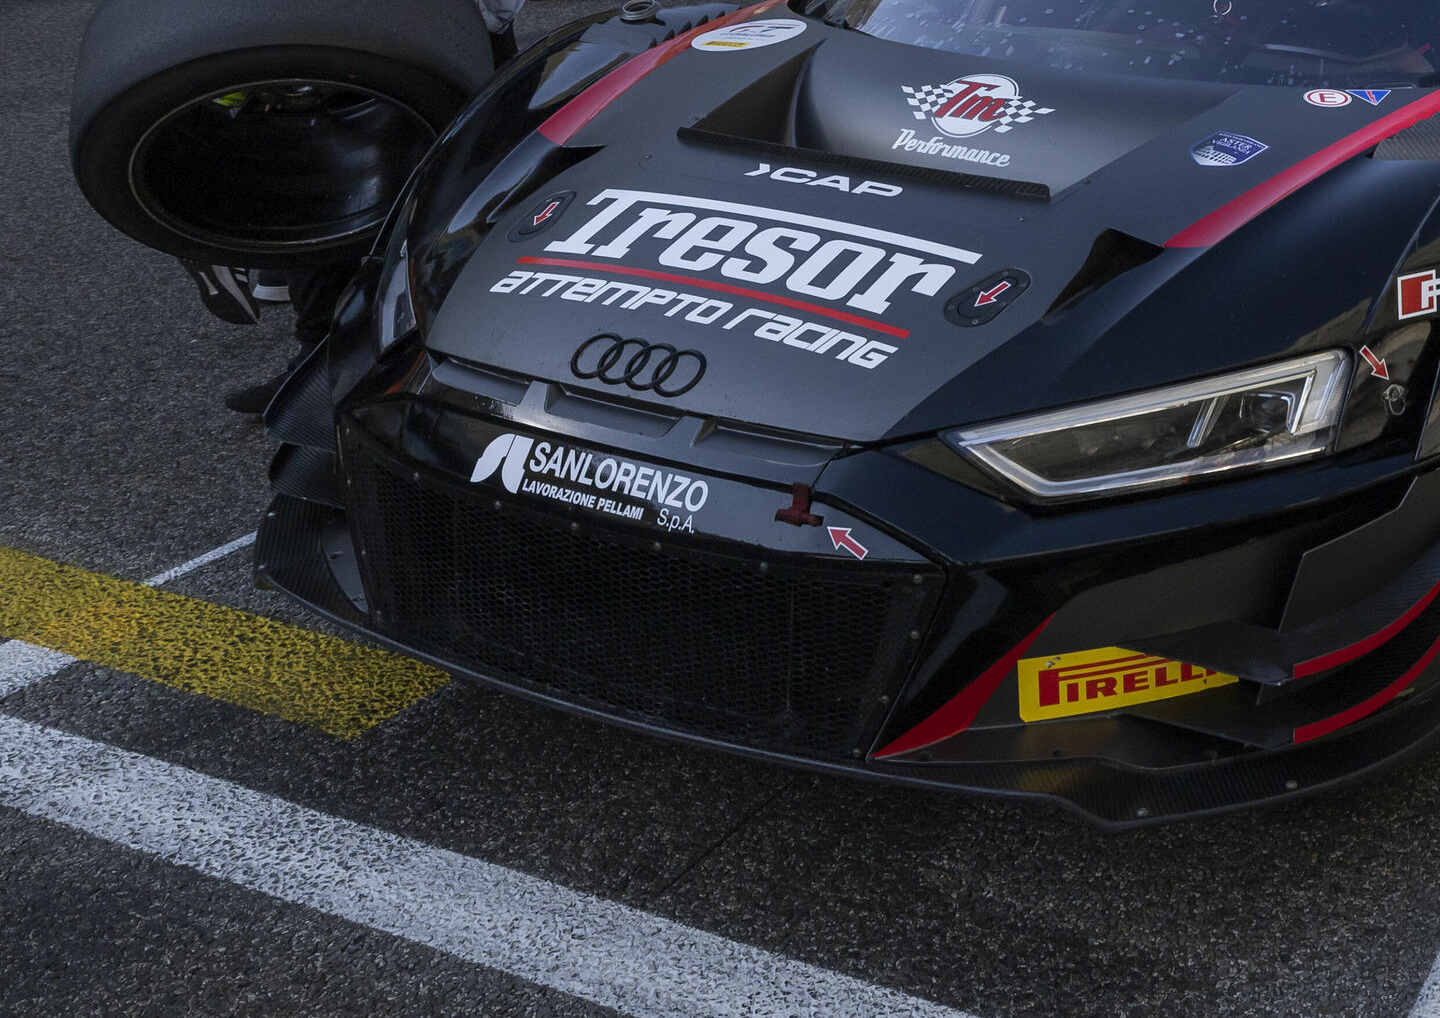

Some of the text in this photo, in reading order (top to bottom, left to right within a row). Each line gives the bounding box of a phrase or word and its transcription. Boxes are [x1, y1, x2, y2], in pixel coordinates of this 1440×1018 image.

[1319, 93, 1338, 103] E
[892, 129, 1011, 167] Performance
[543, 188, 984, 315] Tresor
[529, 441, 709, 512] SANLORENZO
[522, 479, 695, 534] LAVORAZIONE PELLAMI S.p.A.
